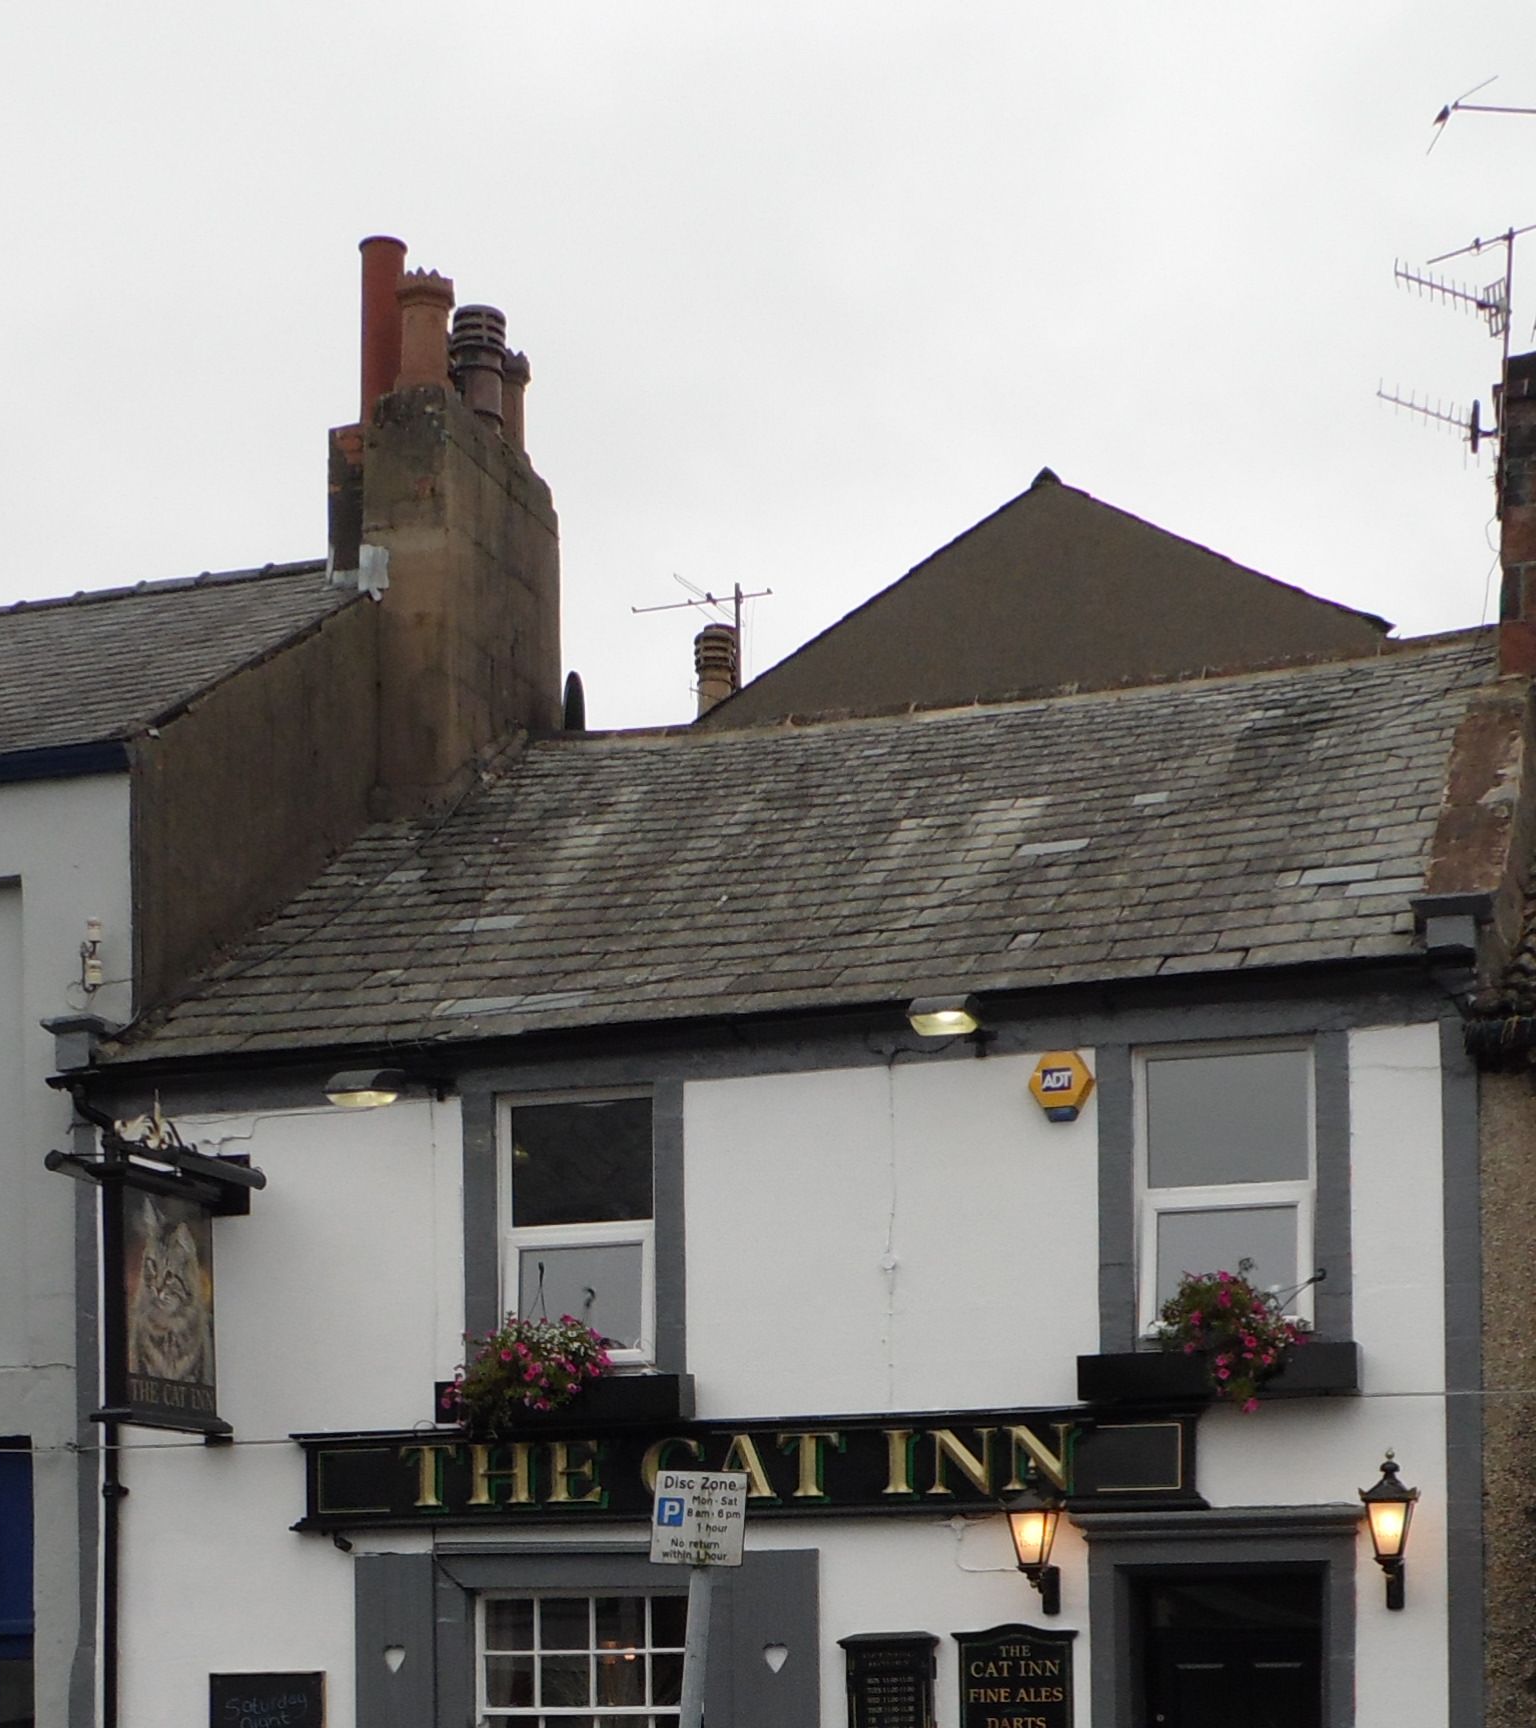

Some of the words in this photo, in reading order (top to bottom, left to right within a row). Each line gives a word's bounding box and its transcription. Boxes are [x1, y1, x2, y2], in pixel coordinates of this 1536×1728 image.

[1042, 1071, 1072, 1089] ADT
[399, 1439, 603, 1508] THE
[640, 1431, 840, 1498] CAT
[881, 1422, 1075, 1496] INN
[664, 1475, 695, 1490] Disc
[700, 1476, 737, 1491] Zone
[691, 1495, 713, 1506] Mon
[720, 1496, 738, 1506] Sat
[705, 1523, 728, 1533] hour
[671, 1538, 685, 1548] No
[689, 1540, 720, 1549] return
[661, 1550, 692, 1560] within
[704, 1550, 728, 1561] hour
[999, 1645, 1032, 1658] THE
[970, 1660, 1013, 1678] CAT
[1019, 1659, 1061, 1677] INN
[969, 1688, 1011, 1703] FINE
[1015, 1687, 1064, 1703] ALES
[223, 1693, 308, 1721] Saturday
